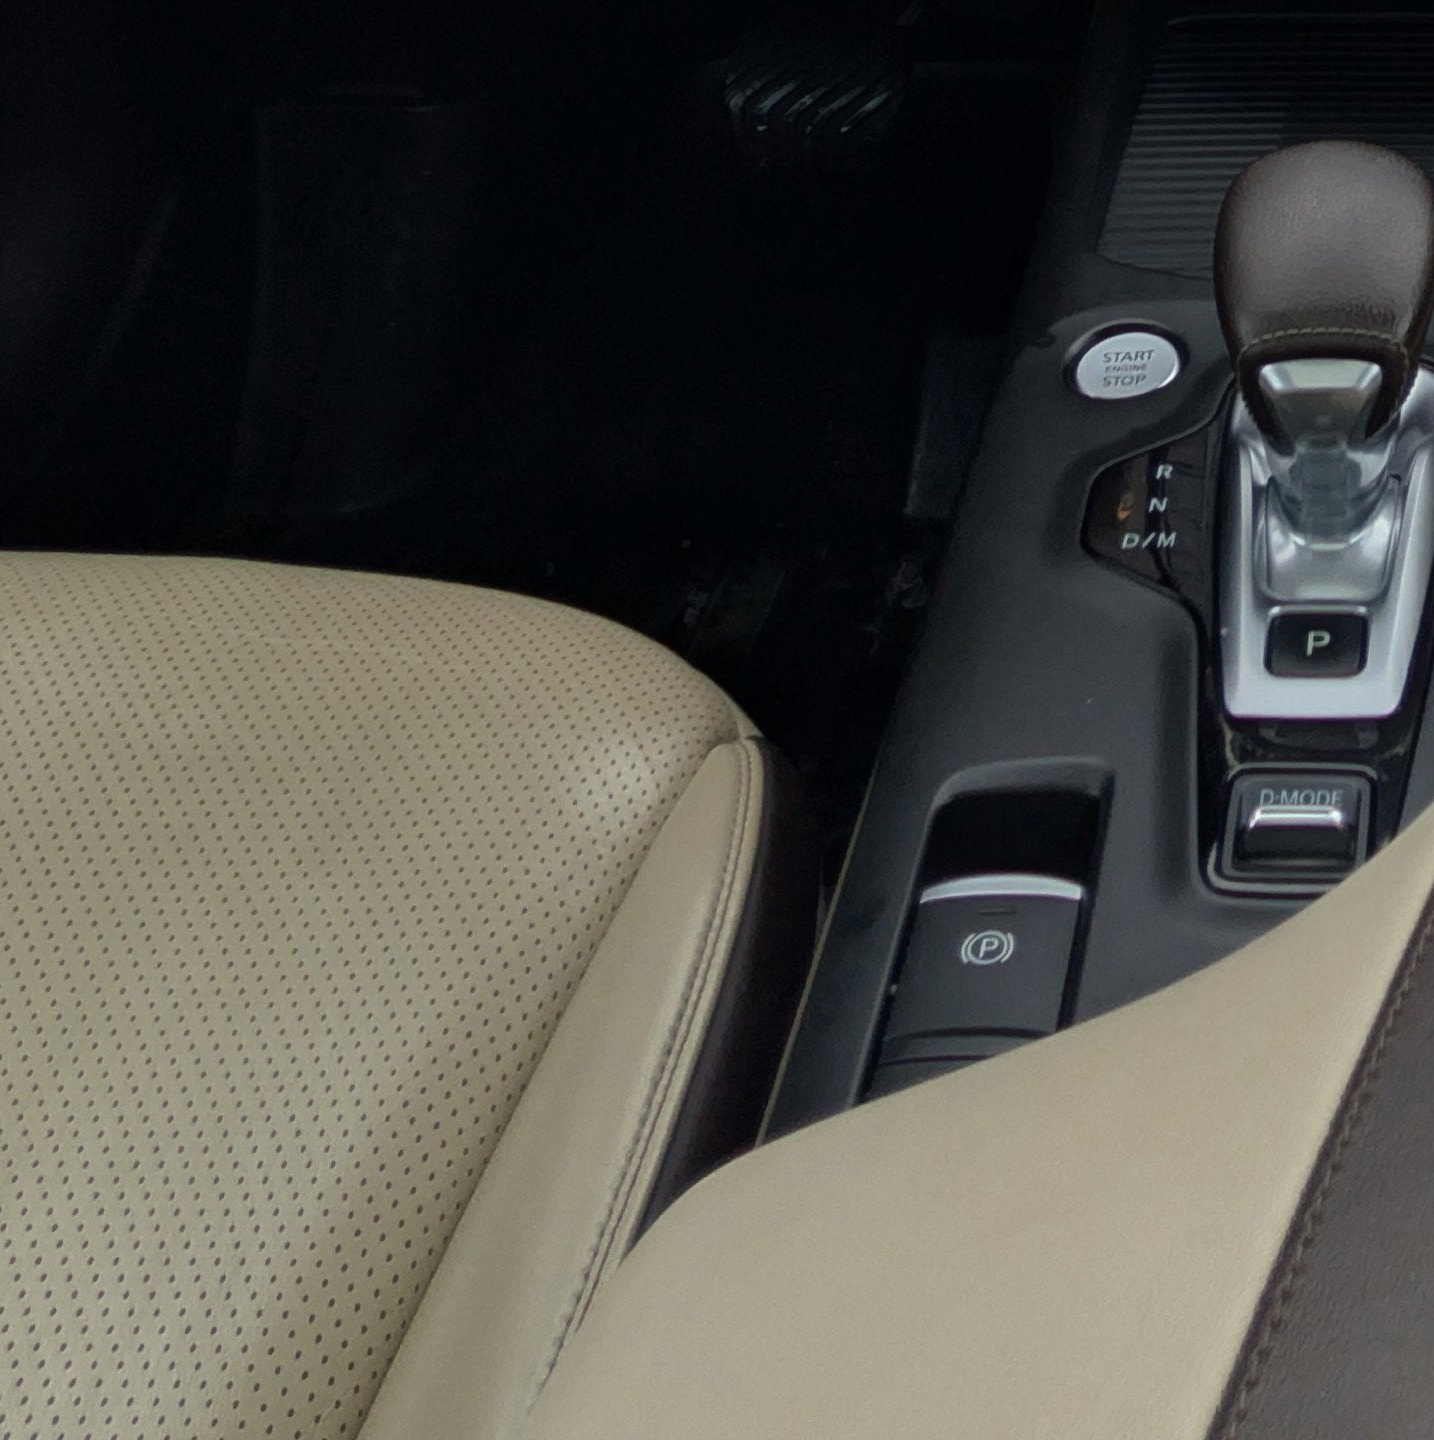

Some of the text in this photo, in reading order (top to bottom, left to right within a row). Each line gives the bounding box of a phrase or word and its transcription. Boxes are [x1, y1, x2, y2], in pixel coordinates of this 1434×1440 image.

[1103, 349, 1155, 364] START
[1105, 364, 1148, 373] ENGINE
[1102, 374, 1147, 387] STOP
[1156, 464, 1174, 480] R
[1148, 497, 1168, 513] N
[1121, 531, 1177, 549] D/M
[1306, 630, 1332, 656] P
